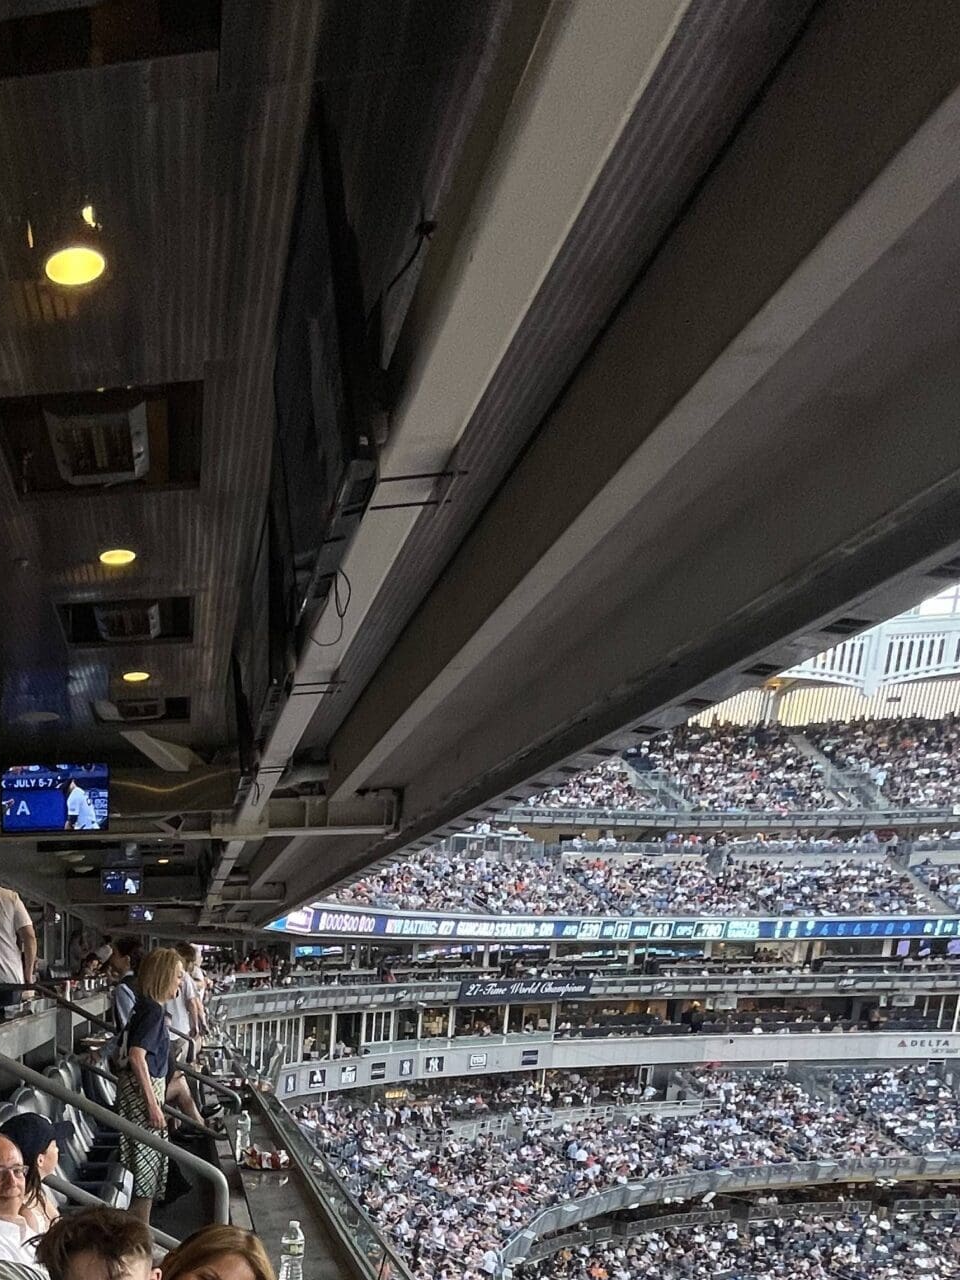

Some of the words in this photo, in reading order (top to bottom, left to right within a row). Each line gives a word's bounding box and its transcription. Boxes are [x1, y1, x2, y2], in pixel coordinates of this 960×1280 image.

[13, 778, 36, 788] JULY
[676, 925, 693, 936] OPS
[837, 924, 845, 935] 5
[853, 923, 861, 935] 6
[870, 923, 878, 935] 7
[885, 923, 894, 935] 8
[902, 922, 911, 934] 9
[465, 982, 508, 997] 27-Time
[510, 981, 539, 995] World
[910, 1039, 949, 1048] DELTA
